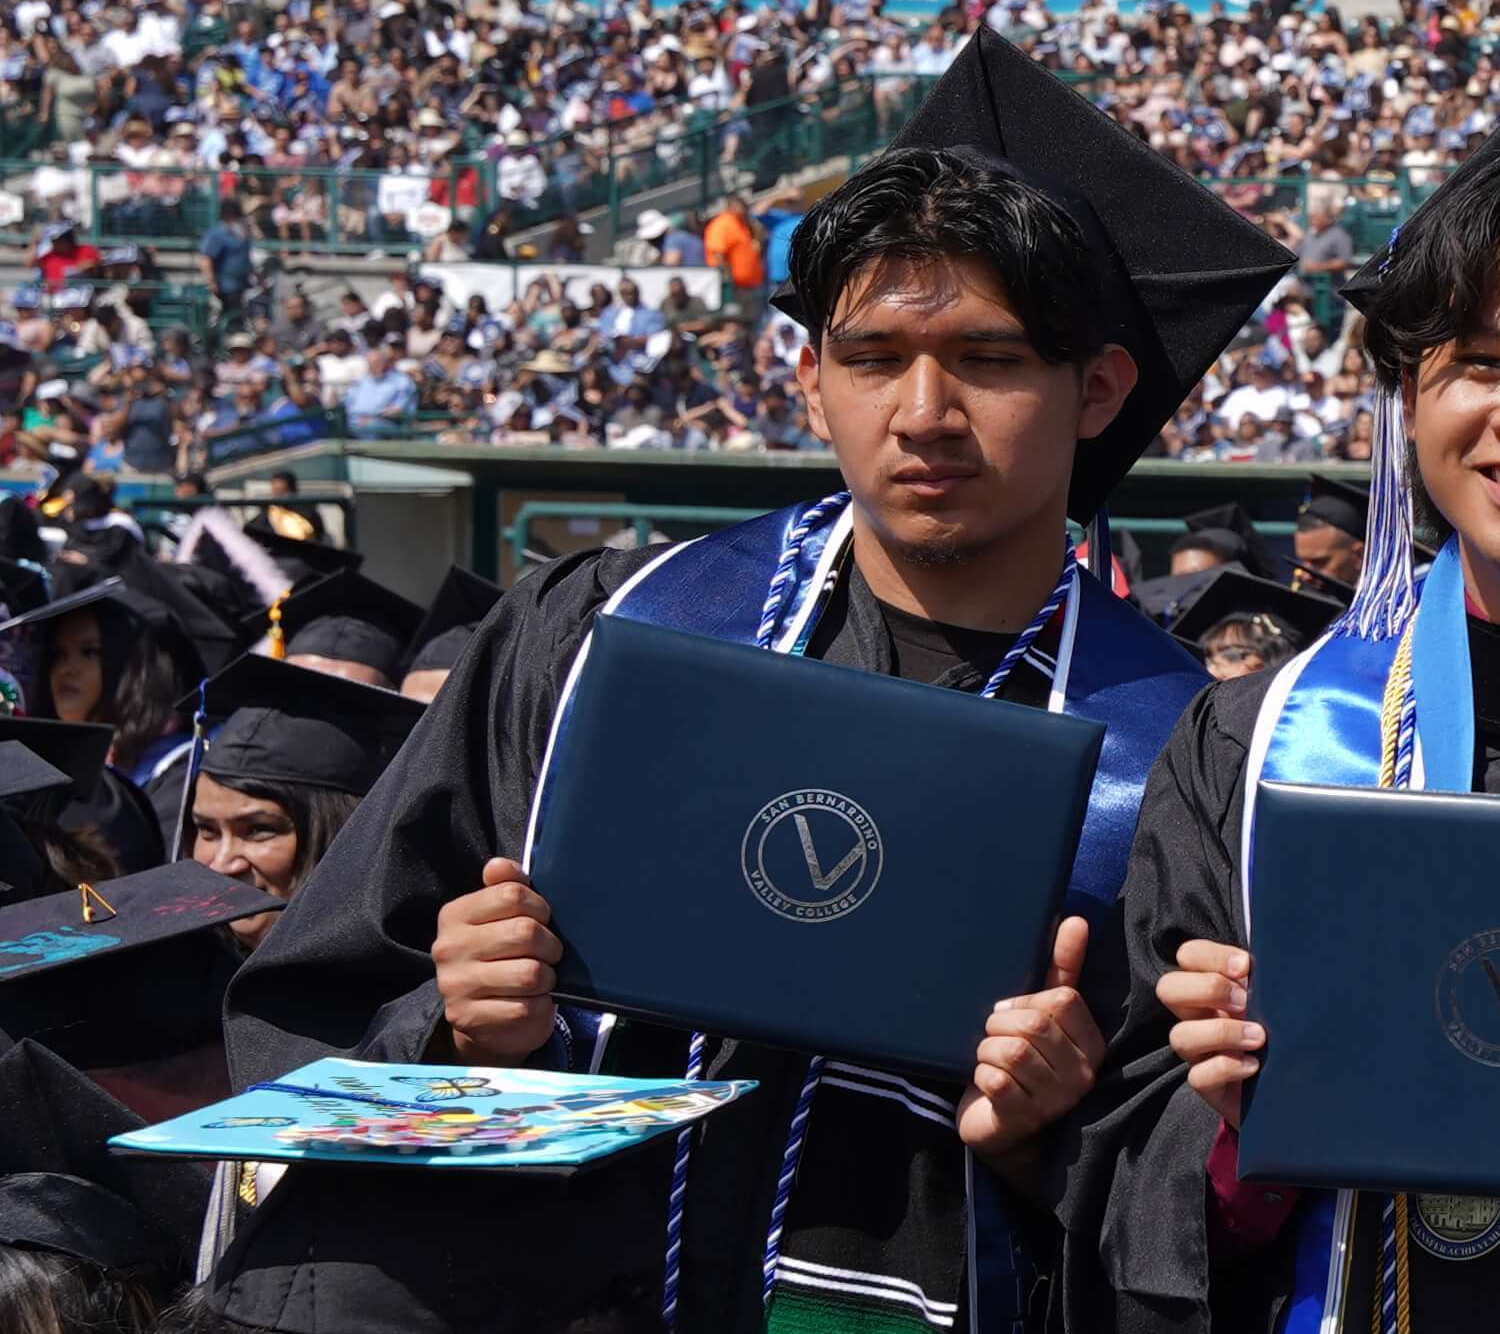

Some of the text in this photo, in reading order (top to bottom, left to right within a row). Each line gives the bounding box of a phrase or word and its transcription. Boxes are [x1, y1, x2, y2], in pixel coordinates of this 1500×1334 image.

[762, 794, 877, 850] SAN BERNARDINO
[794, 814, 865, 890] V
[751, 870, 857, 917] VALLEY COLLEGE
